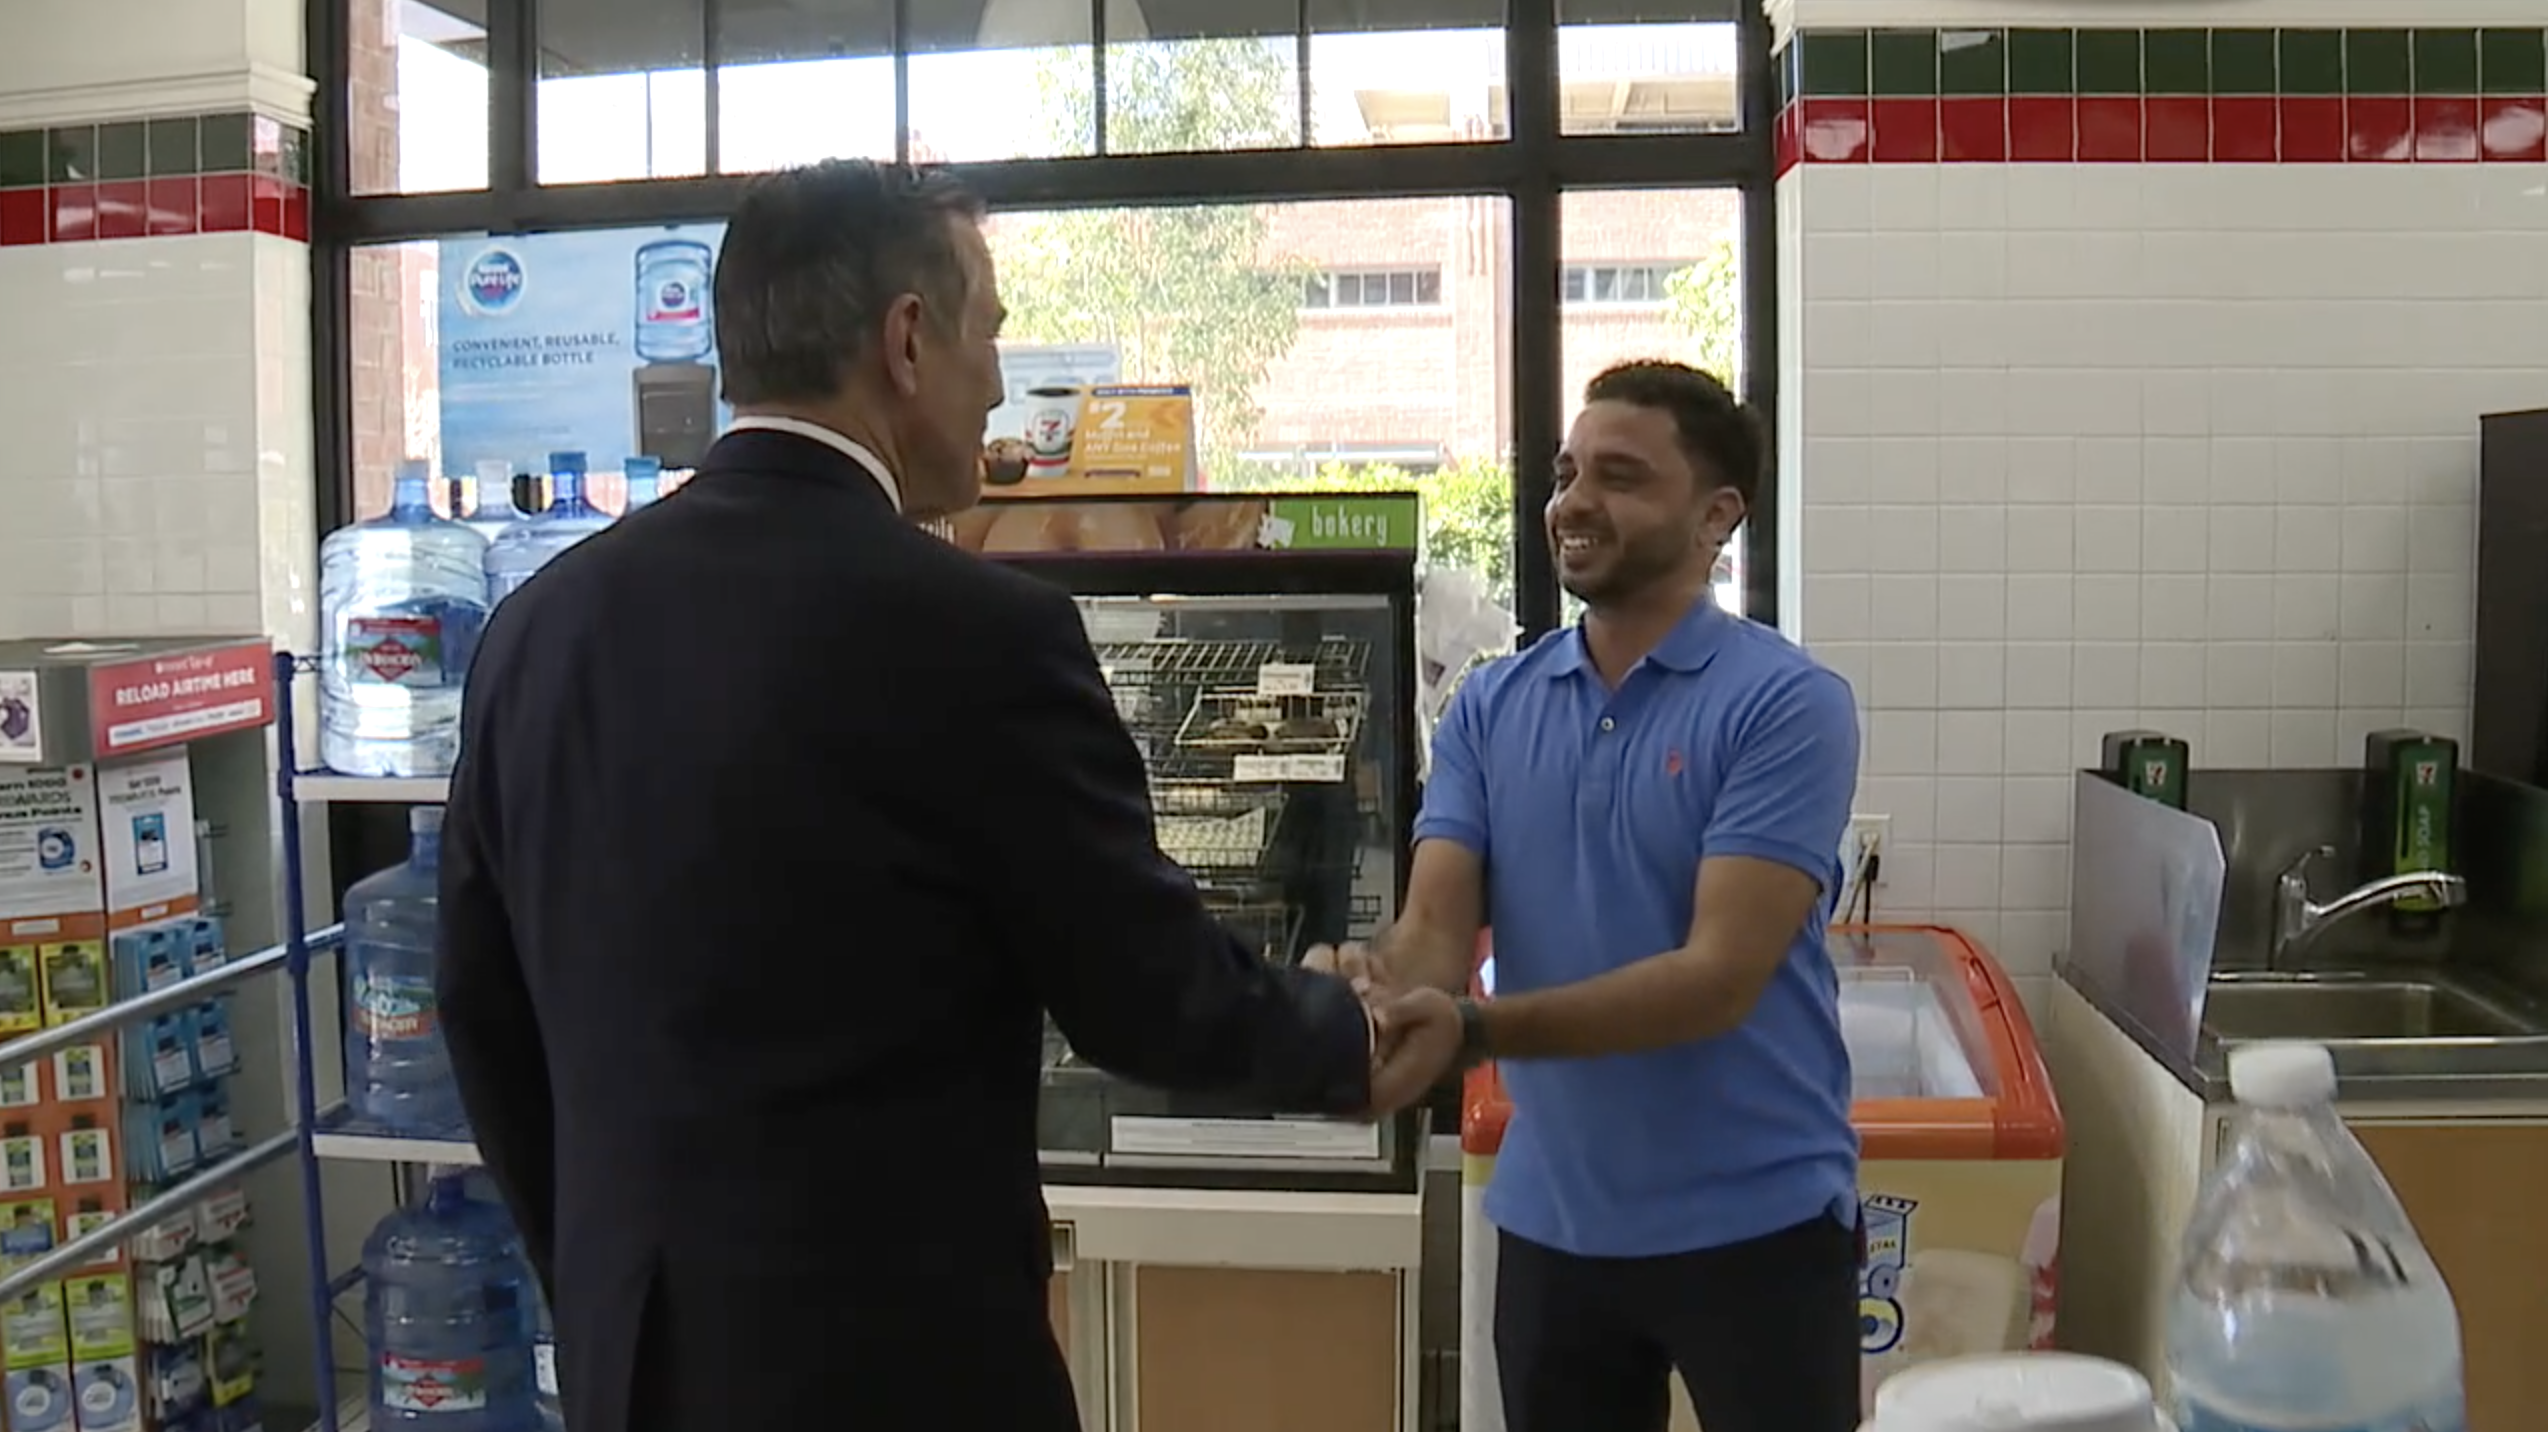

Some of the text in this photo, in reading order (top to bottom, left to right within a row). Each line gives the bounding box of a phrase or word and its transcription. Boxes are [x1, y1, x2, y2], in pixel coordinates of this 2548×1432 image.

[453, 332, 621, 353] CONVENIENT, REUSABLE,
[453, 351, 594, 369] RECYCLABLE BOTTLE
[1312, 505, 1387, 547] bakery
[115, 682, 170, 706] RELOAD
[172, 672, 221, 697] AIRTIME
[223, 667, 256, 688] HERE
